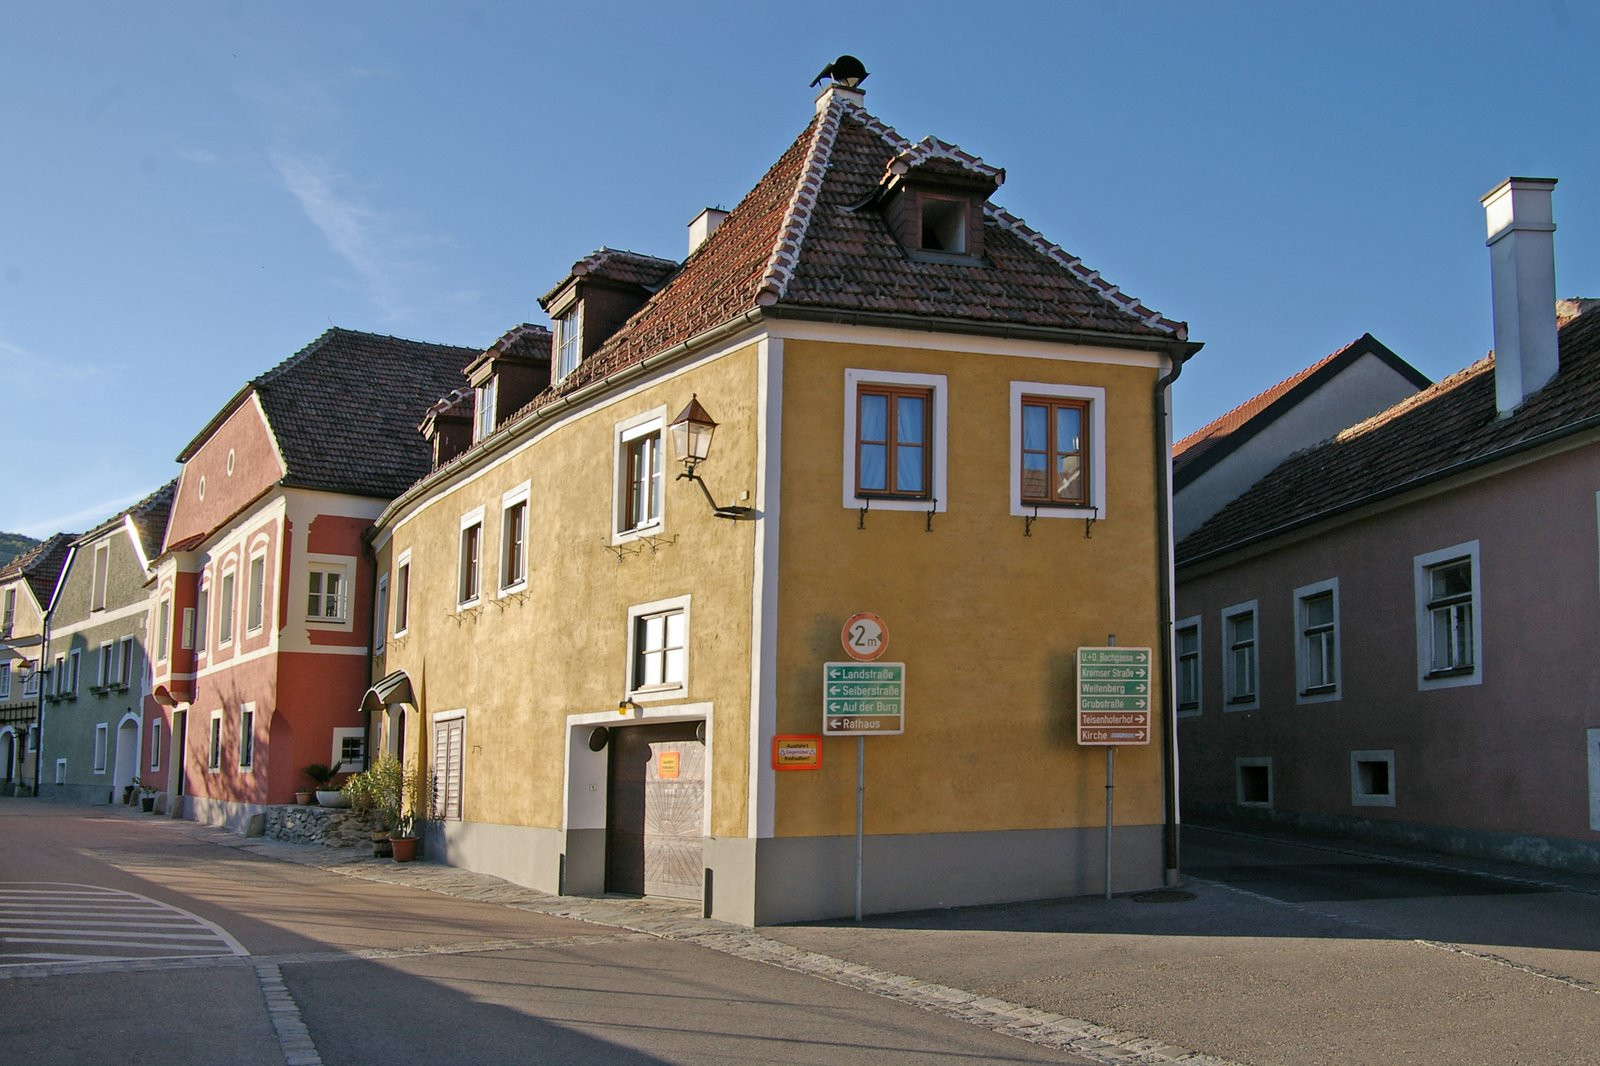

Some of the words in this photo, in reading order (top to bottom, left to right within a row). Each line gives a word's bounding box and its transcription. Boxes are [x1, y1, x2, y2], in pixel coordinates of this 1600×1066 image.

[1099, 653, 1134, 663] Bachgasse
[842, 668, 894, 679] Landstraße
[1081, 668, 1110, 677] Kremser
[1113, 669, 1134, 678] Straße
[842, 685, 900, 696] Seiberstraße
[1081, 684, 1125, 694] Weitenberg
[842, 701, 857, 712] Auf
[859, 701, 874, 712] der
[876, 702, 898, 714] Burg
[1081, 699, 1124, 708] Grubstraße
[842, 718, 881, 729] Rathaus
[1082, 715, 1134, 724] Teisenhoferhof
[1082, 731, 1108, 740] Kirche
